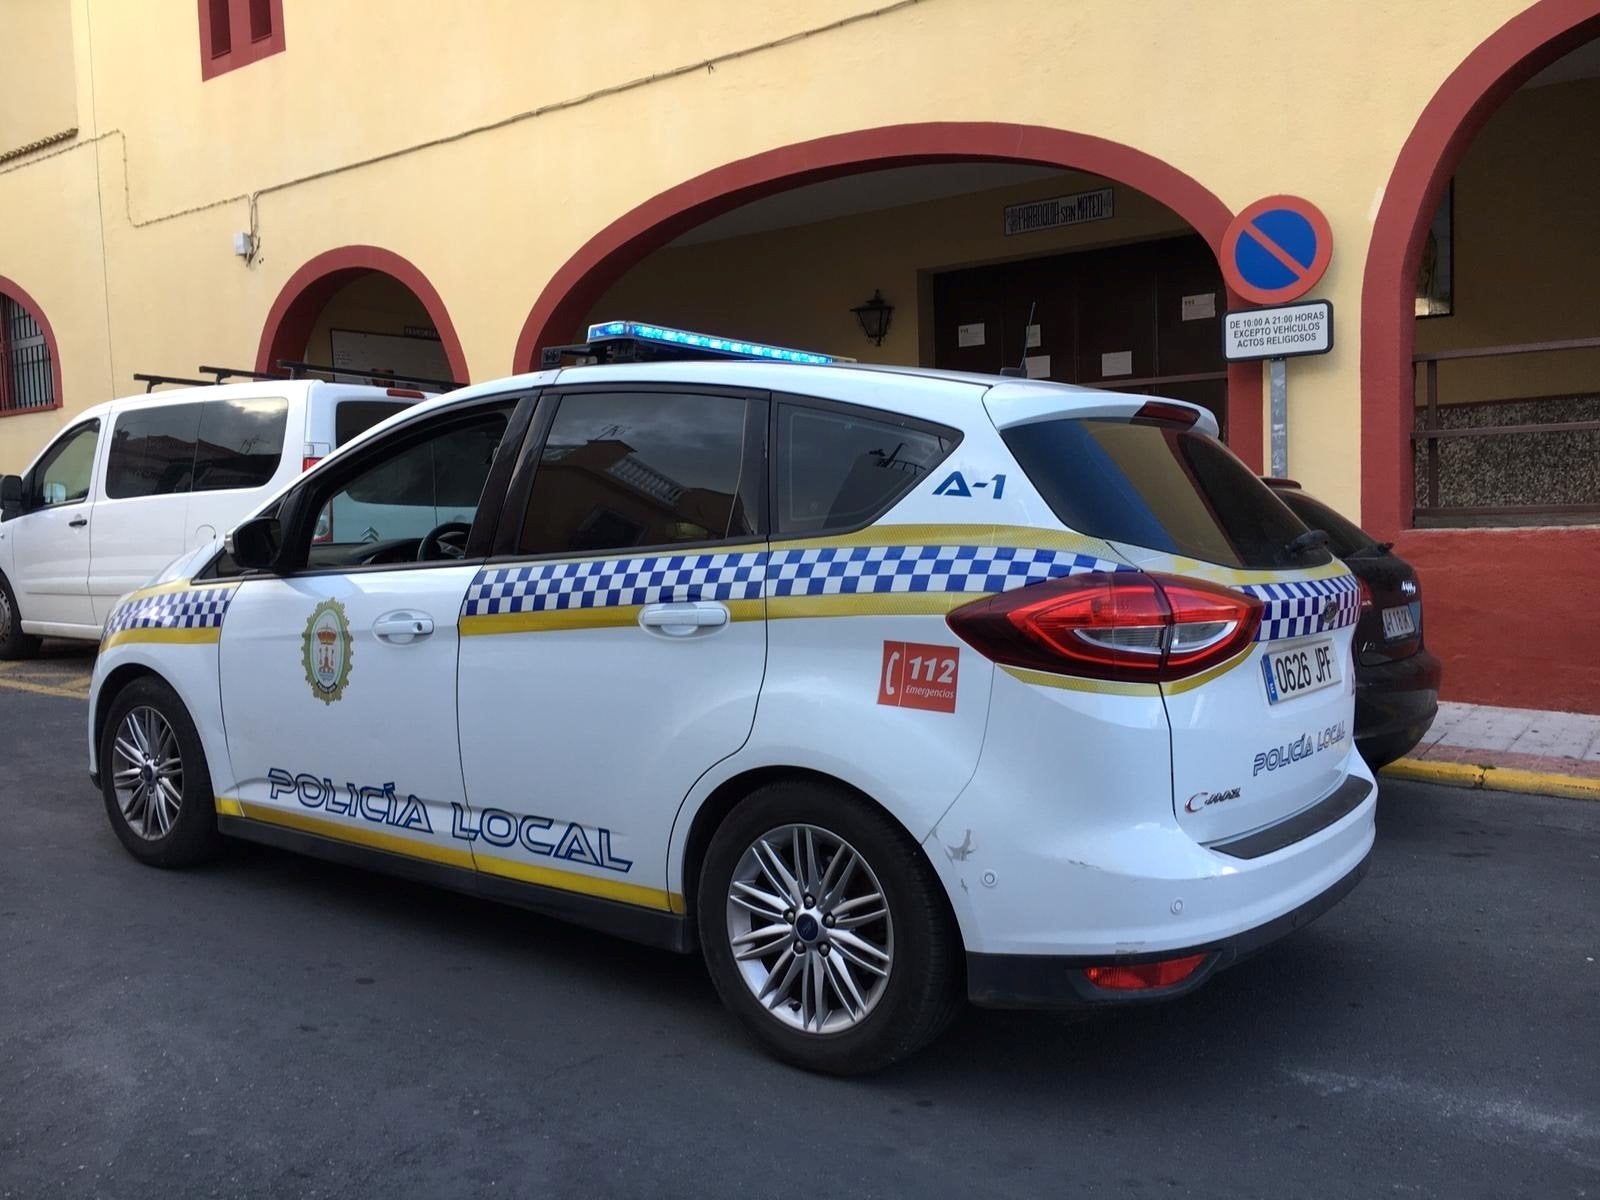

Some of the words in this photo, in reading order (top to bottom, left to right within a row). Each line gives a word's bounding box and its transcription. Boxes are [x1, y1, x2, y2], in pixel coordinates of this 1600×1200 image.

[1061, 204, 1076, 224] SAN
[1230, 320, 1240, 329] DE
[1243, 318, 1263, 327] 10:00
[1264, 317, 1271, 326] A
[1272, 315, 1293, 325] 21:00
[1295, 311, 1325, 321] HORAS
[1234, 327, 1271, 339] EXCEPTO
[1273, 321, 1320, 335] VEHÍCULOS
[1237, 338, 1265, 348] ACTOS
[1266, 332, 1317, 345] RELIGIOSOS
[931, 470, 1007, 500] A-1
[909, 655, 956, 684] 112
[1275, 651, 1312, 694] 0626
[1315, 646, 1333, 683] JPF
[905, 684, 955, 699] Emergencias
[1253, 733, 1314, 777] POLICÍA
[1316, 720, 1346, 752] LOCAL
[267, 767, 434, 834] POLICÍA
[449, 802, 633, 873] LOCAL
